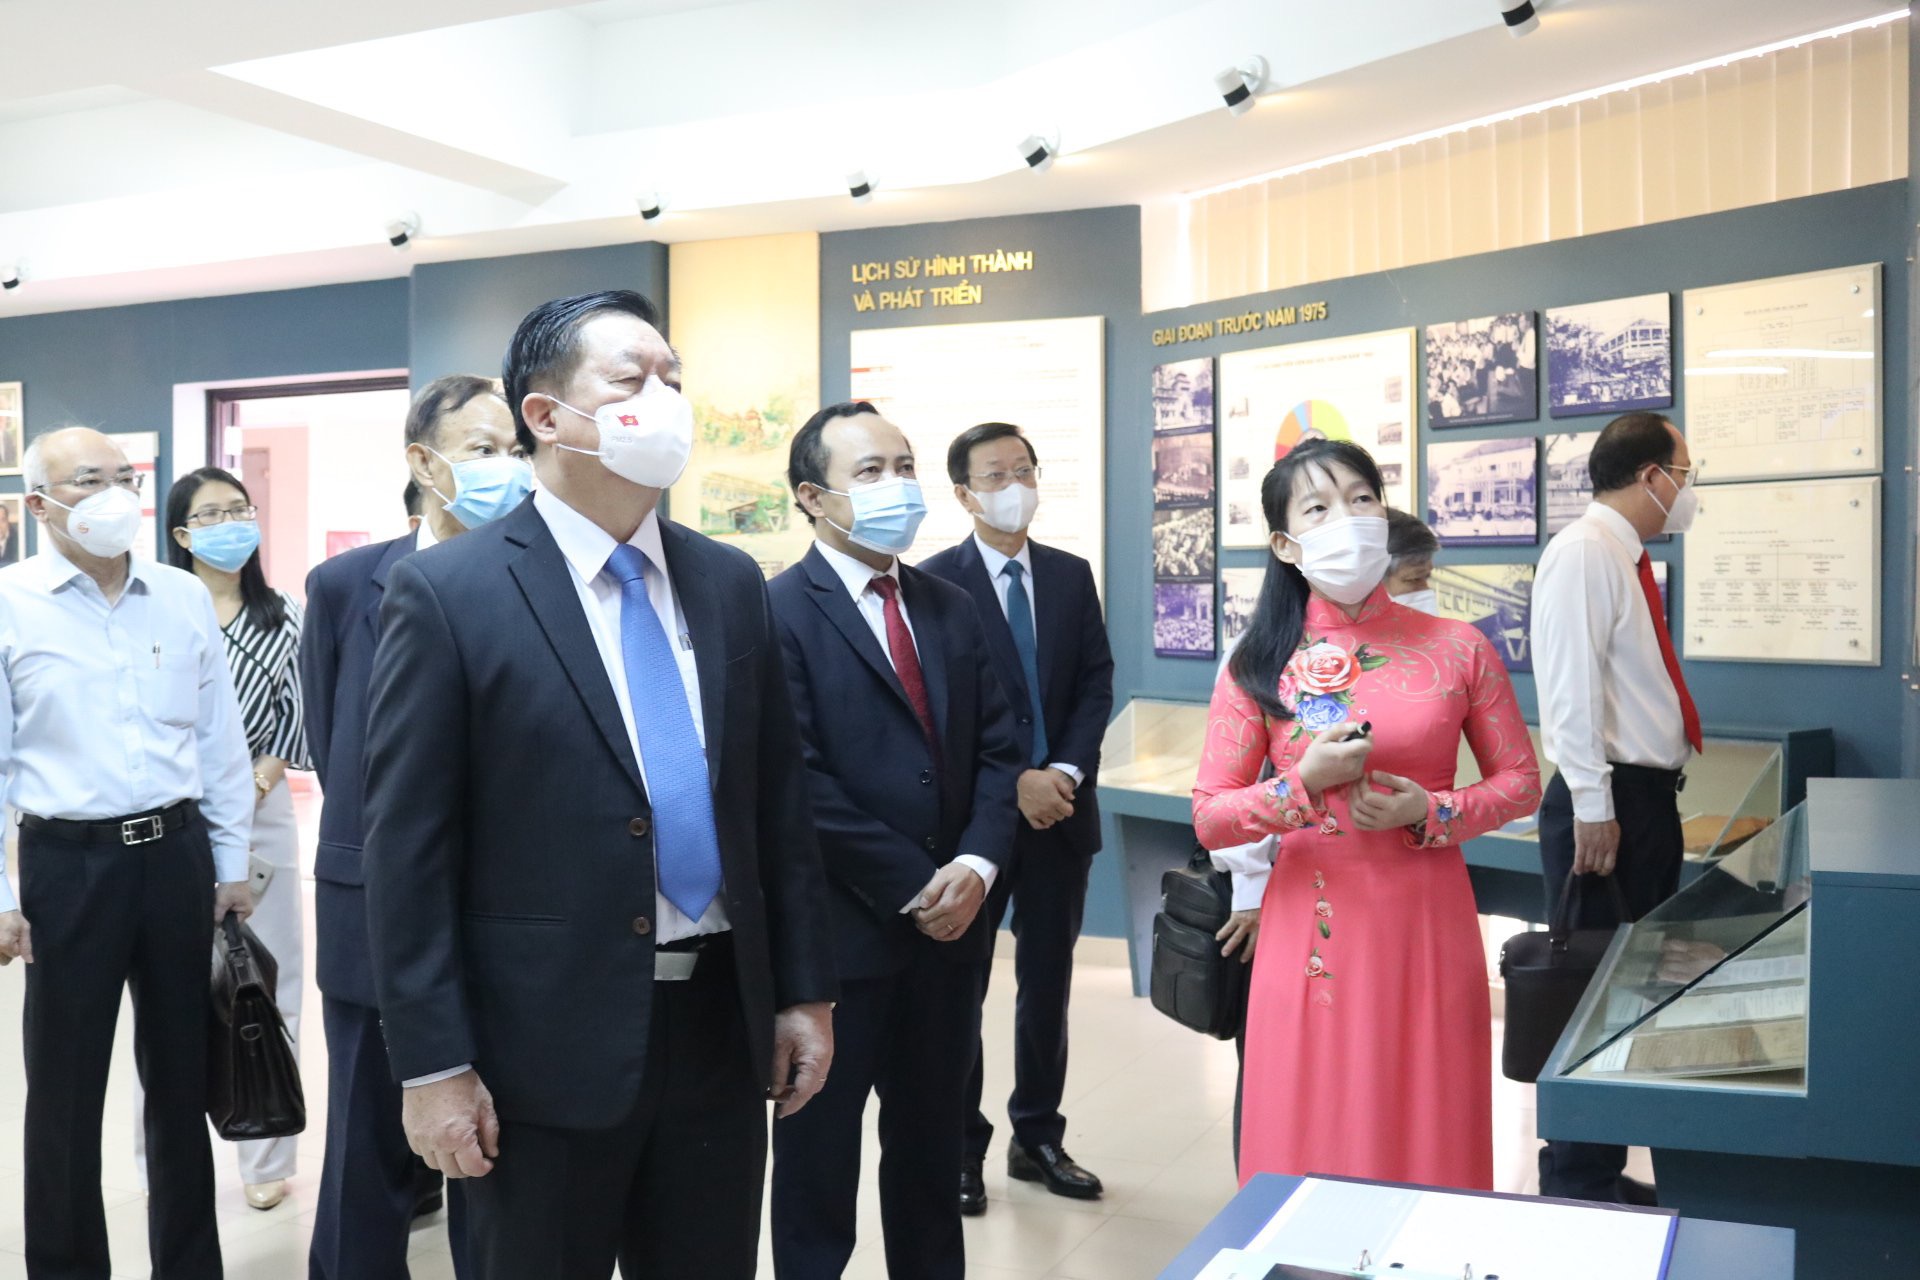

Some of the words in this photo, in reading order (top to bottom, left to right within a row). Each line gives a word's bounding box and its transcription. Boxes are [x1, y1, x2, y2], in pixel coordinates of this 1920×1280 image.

[852, 262, 890, 285] LỊCH
[894, 256, 921, 279] SỬ
[925, 254, 966, 277] HÌNH
[969, 249, 1034, 273] THÀNH
[853, 290, 875, 312] VÀ
[880, 286, 924, 310] PHÁT
[930, 279, 982, 306] TRIỂN
[1152, 328, 1177, 346] GIAI
[1178, 321, 1214, 343] ĐOẠN
[1216, 310, 1263, 336] TRƯỚC
[1265, 305, 1297, 327] NĂM
[1299, 301, 1328, 322] 1975
